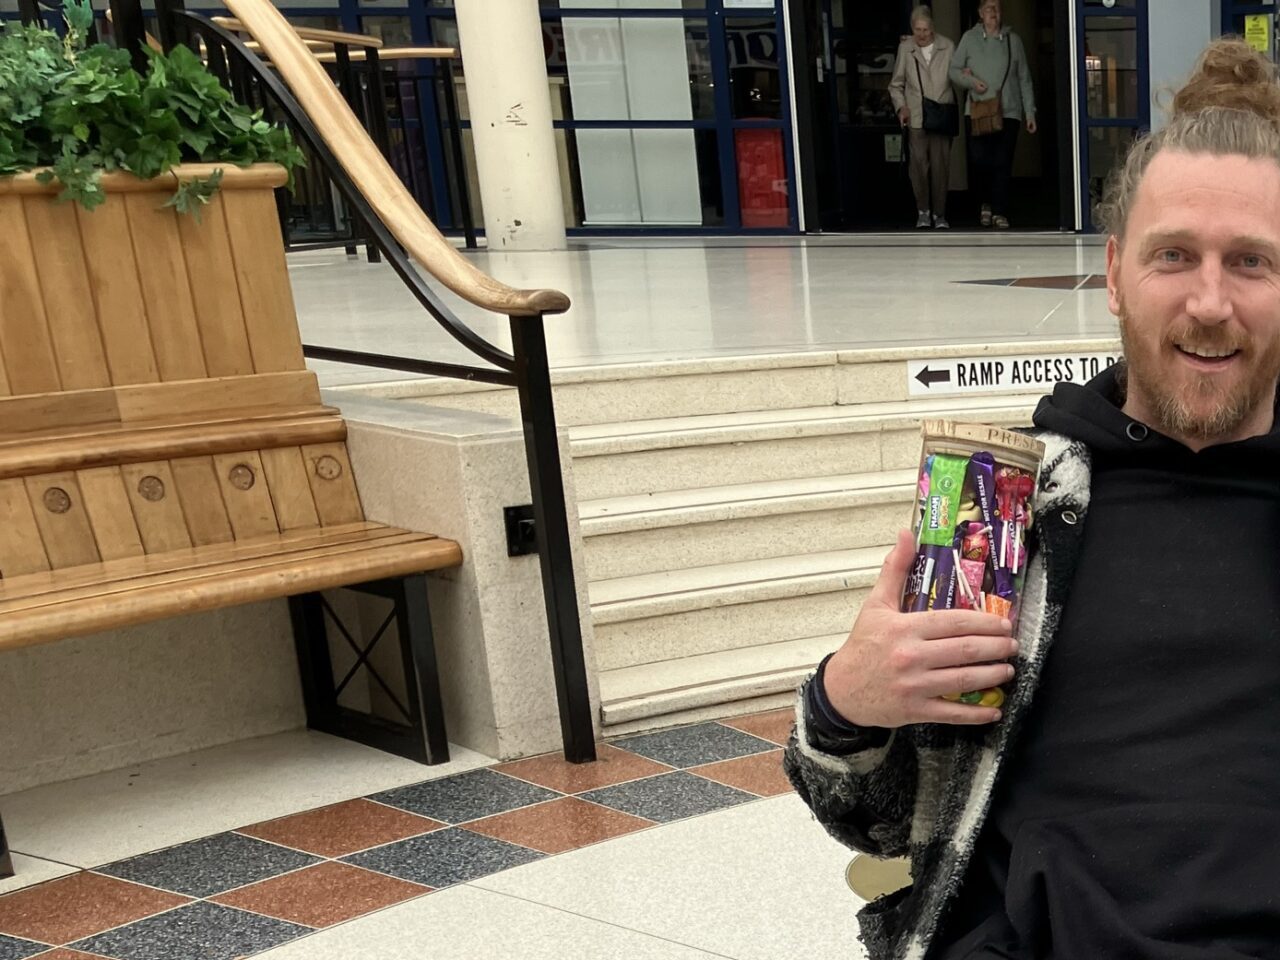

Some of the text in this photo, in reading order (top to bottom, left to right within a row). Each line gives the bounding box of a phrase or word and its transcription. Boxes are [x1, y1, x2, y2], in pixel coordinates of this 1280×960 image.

[957, 362, 1004, 387] RAMP
[1011, 358, 1074, 384] ACCESS
[1080, 357, 1099, 380] TO
[930, 497, 940, 528] MAOAM
